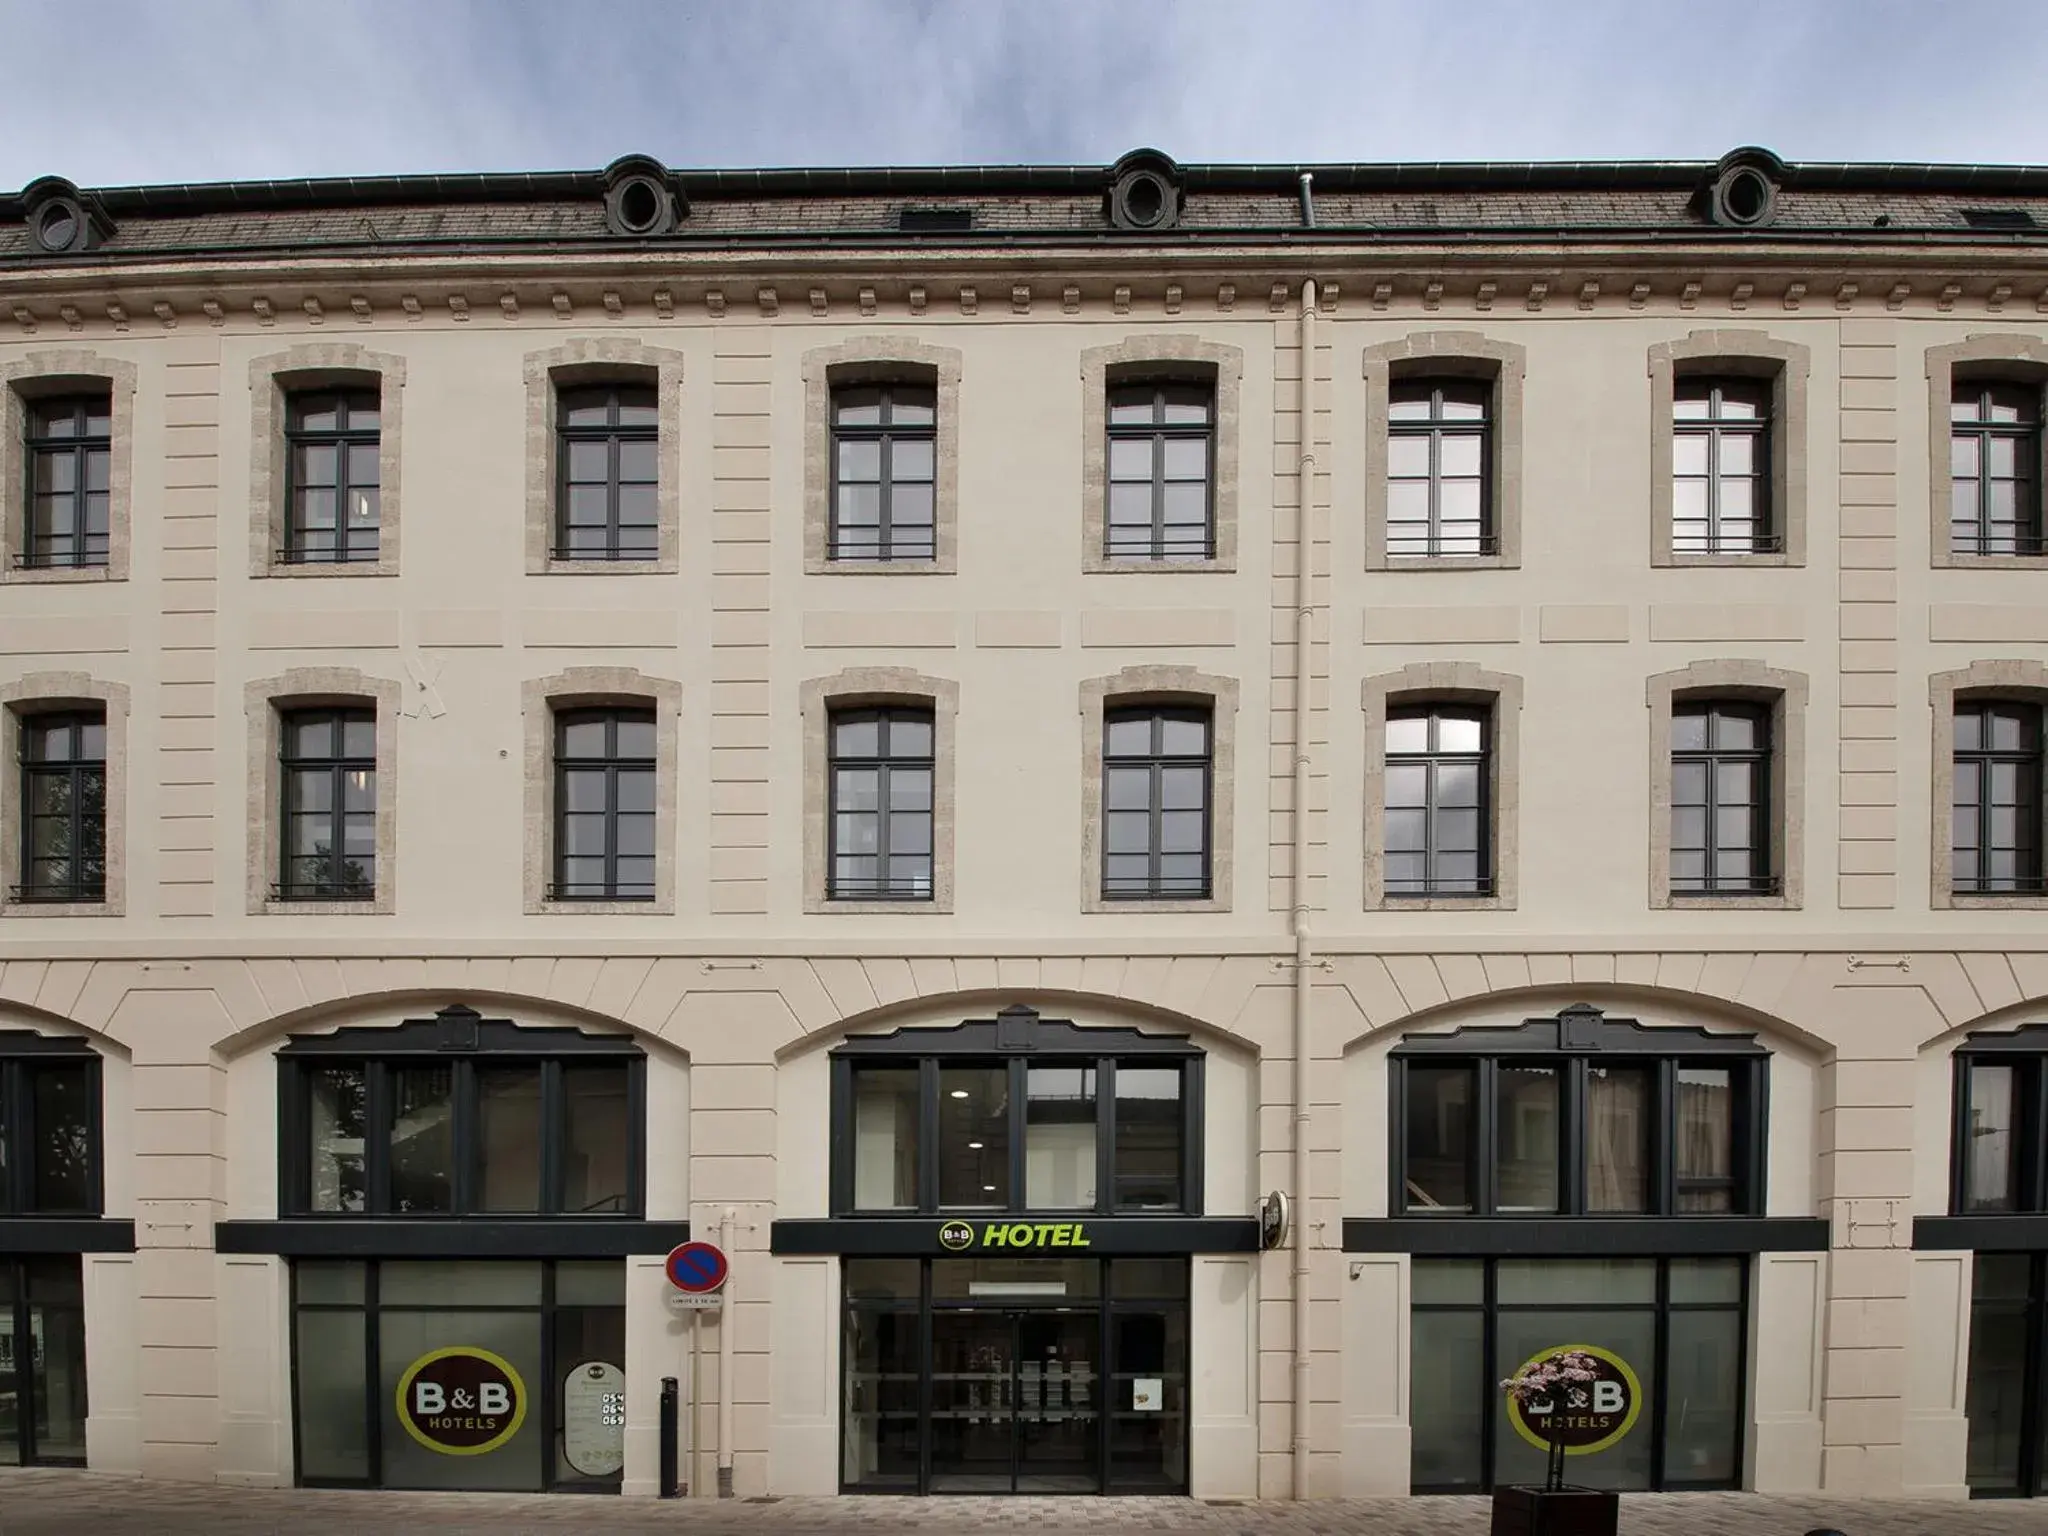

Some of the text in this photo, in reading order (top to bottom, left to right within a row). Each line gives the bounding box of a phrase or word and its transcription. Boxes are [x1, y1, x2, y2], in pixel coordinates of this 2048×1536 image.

[983, 1224, 1091, 1246] HOTEL
[416, 1382, 510, 1414] B&B
[429, 1417, 497, 1429] HOTELS
[602, 1416, 625, 1425] 069
